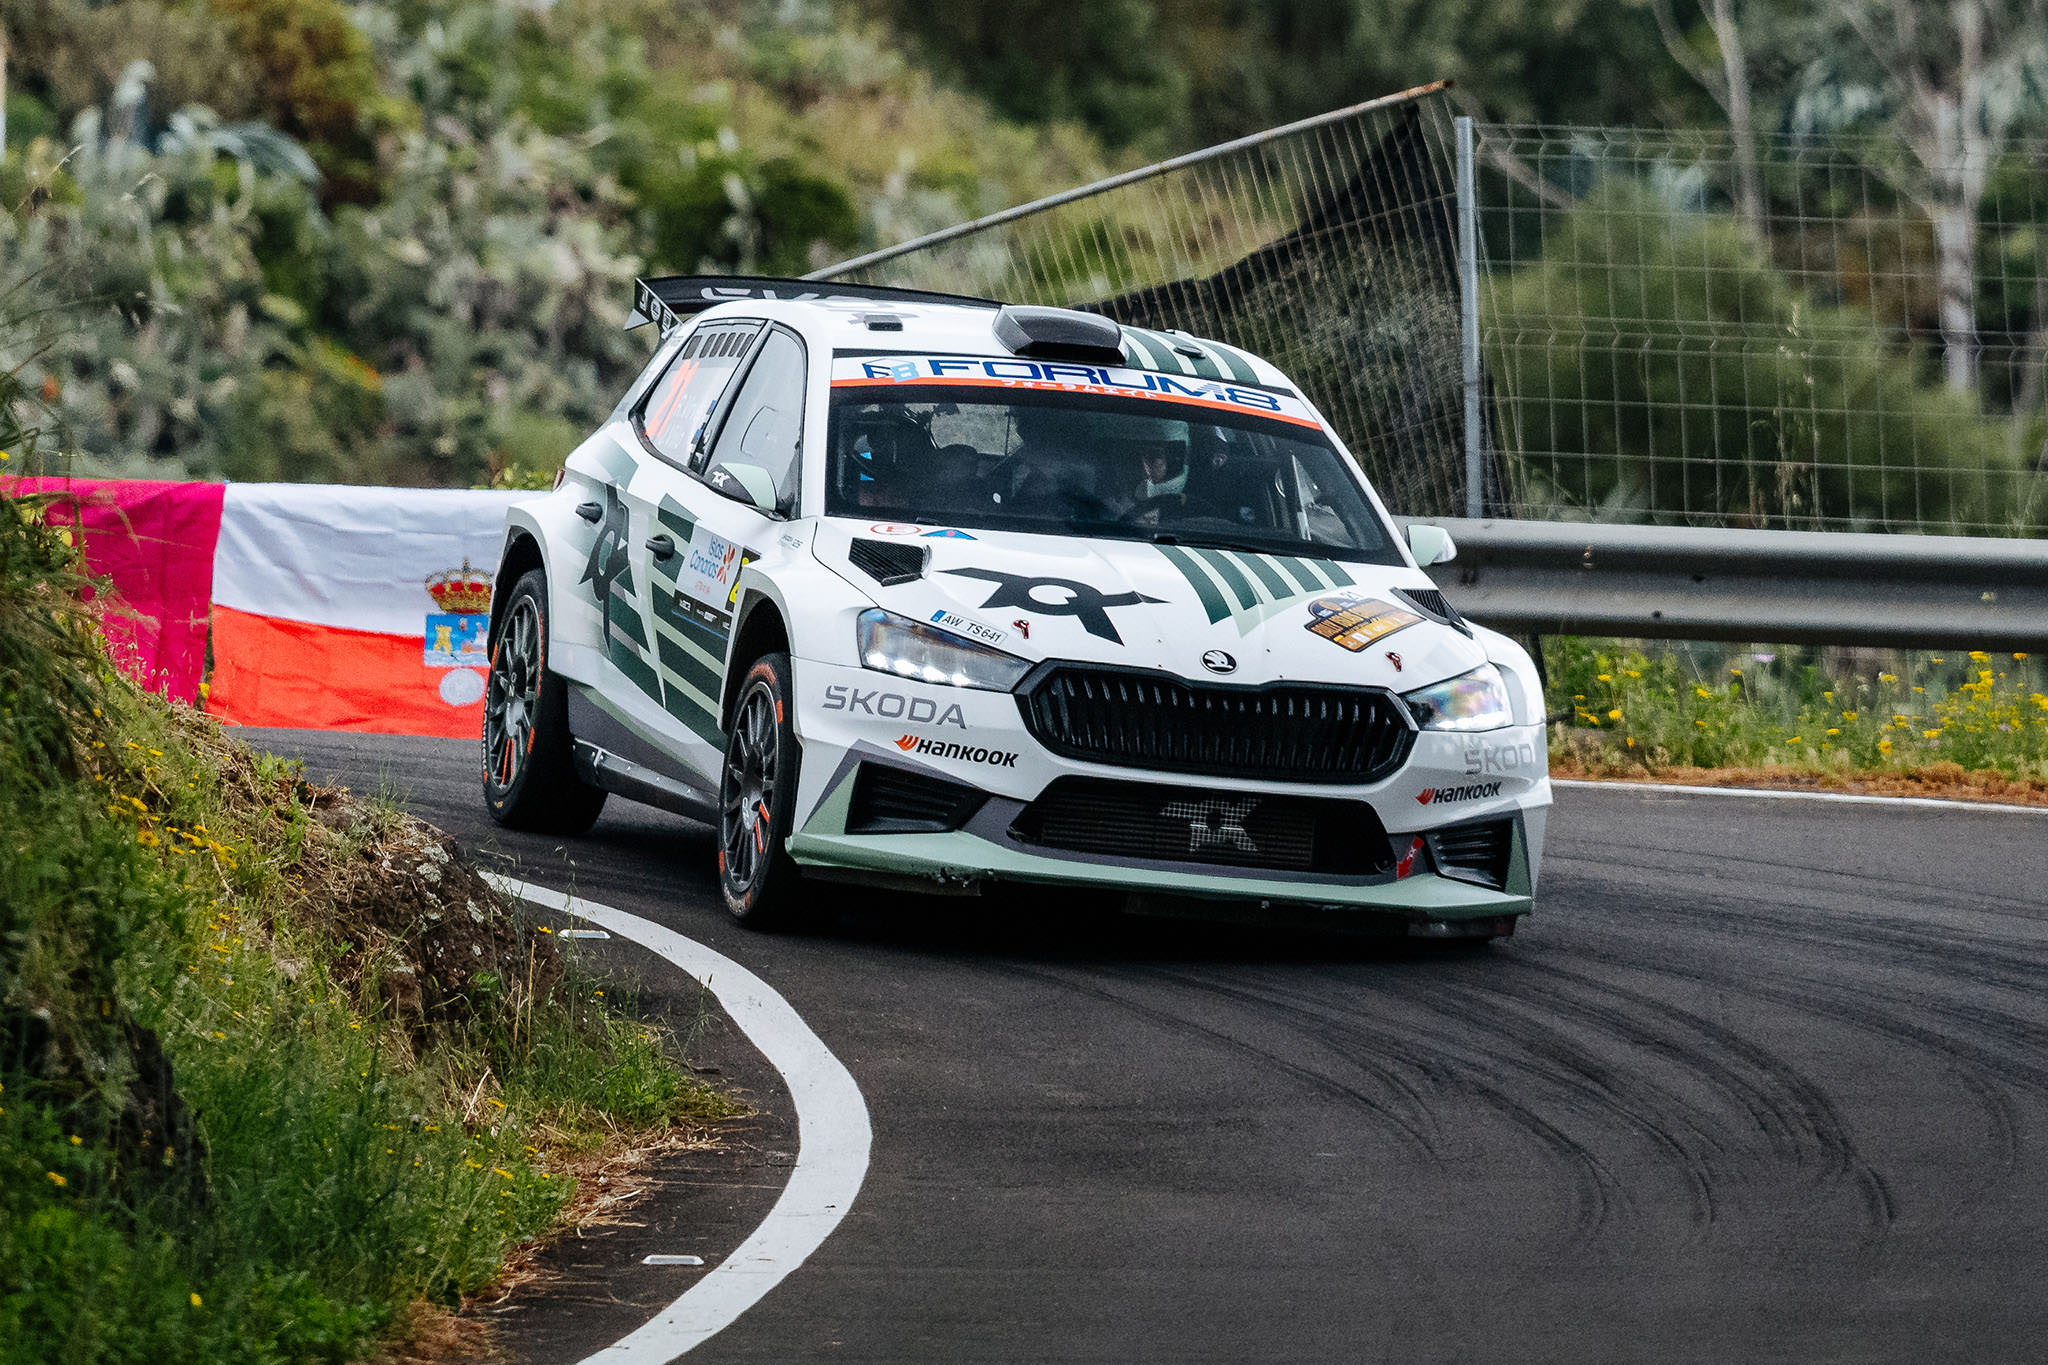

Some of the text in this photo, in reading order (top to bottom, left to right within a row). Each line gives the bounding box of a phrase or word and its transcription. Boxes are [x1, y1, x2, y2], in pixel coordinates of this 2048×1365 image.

[927, 359, 1281, 412] FORUM8
[708, 535, 724, 560] Islas
[690, 549, 719, 579] Canarias
[941, 615, 964, 627] AW
